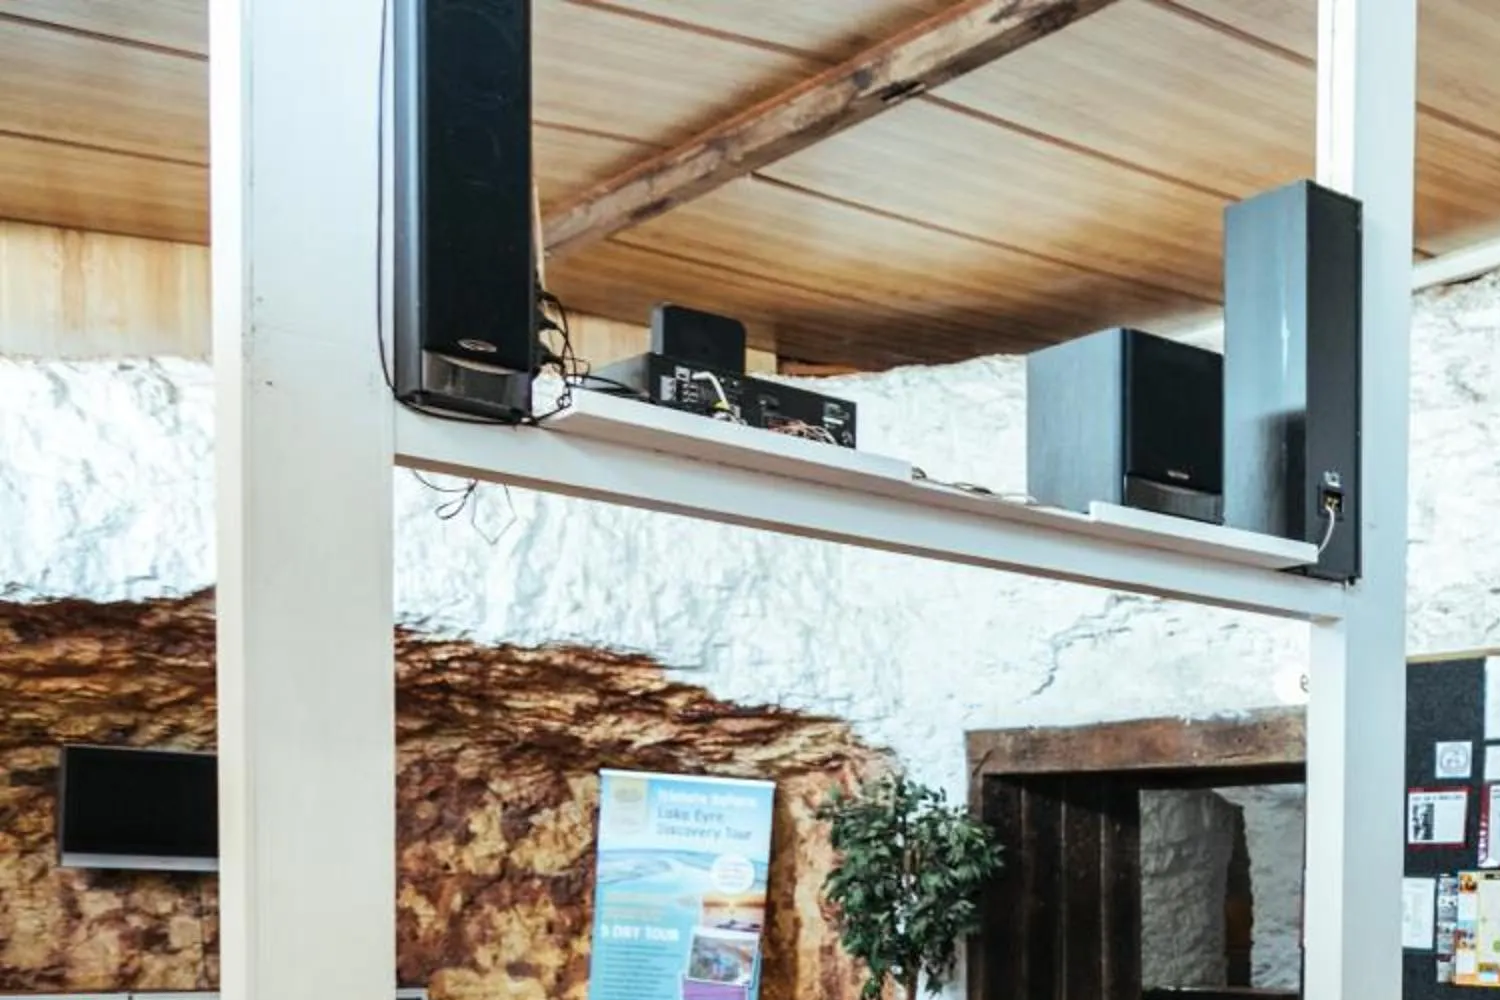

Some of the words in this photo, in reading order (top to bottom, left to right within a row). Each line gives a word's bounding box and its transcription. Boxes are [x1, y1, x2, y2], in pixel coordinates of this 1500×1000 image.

[657, 806, 690, 821] Lake
[693, 808, 725, 825] Eyre
[656, 821, 722, 842] Discovery
[725, 826, 752, 841] Tour
